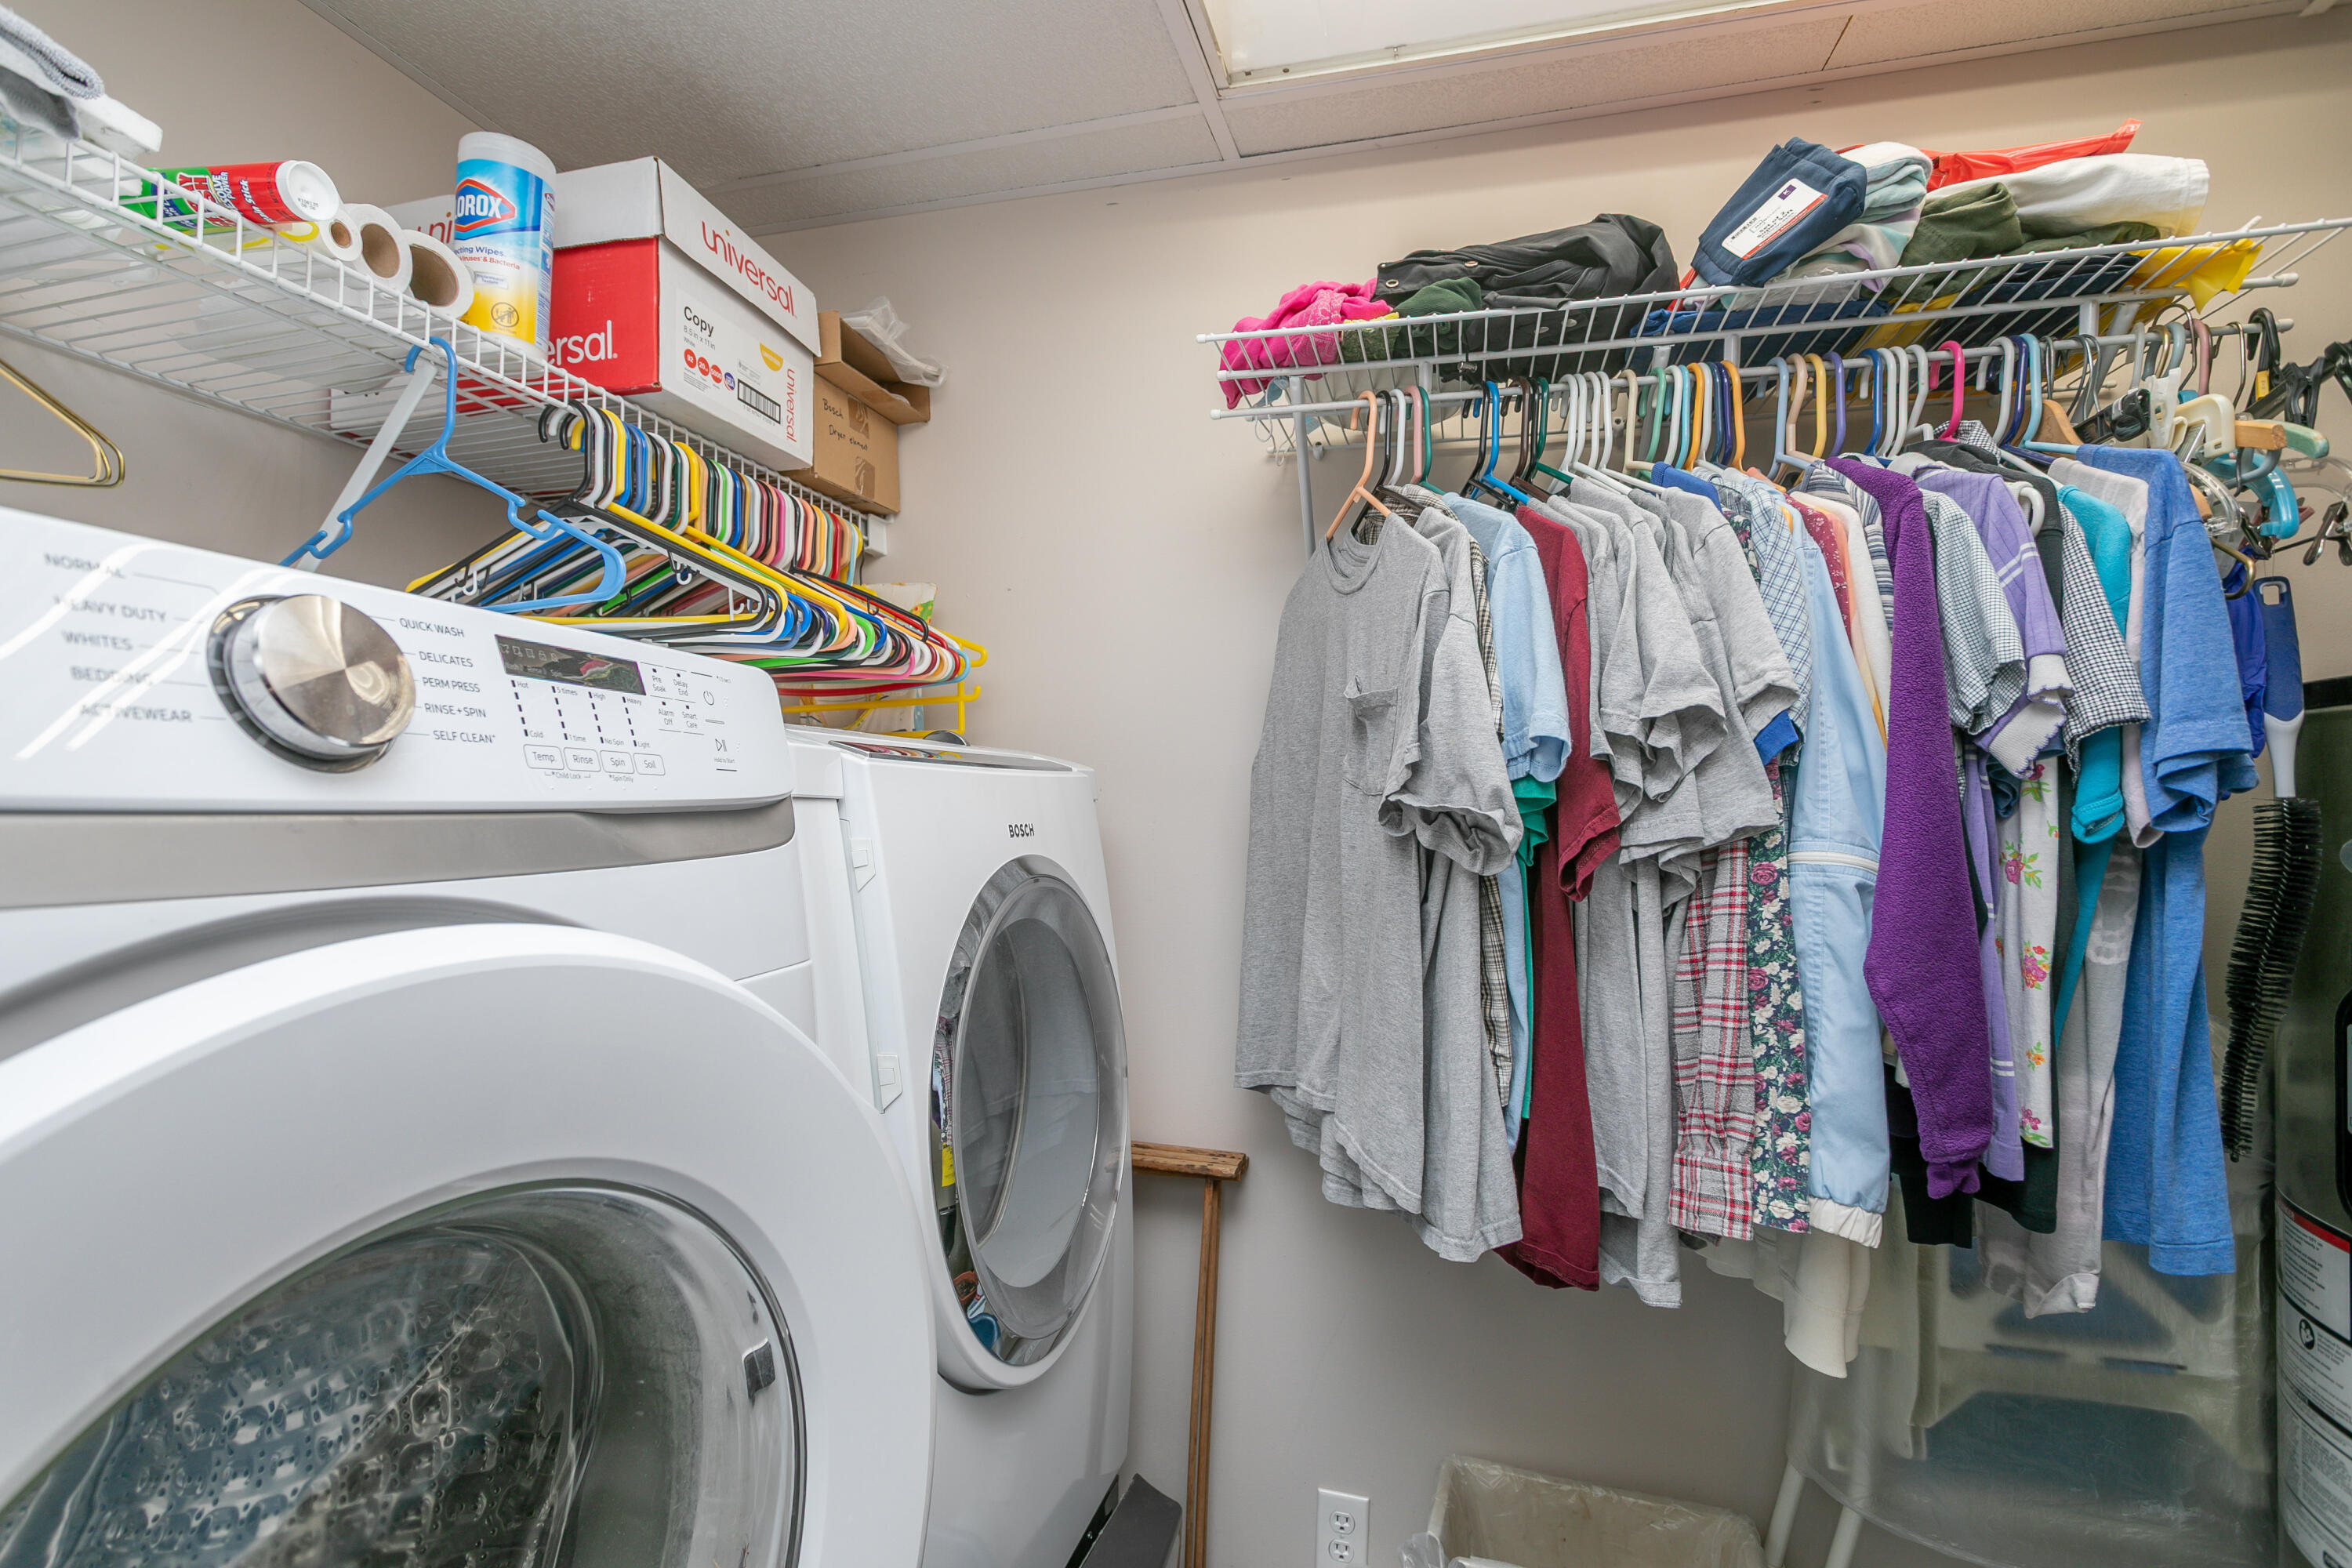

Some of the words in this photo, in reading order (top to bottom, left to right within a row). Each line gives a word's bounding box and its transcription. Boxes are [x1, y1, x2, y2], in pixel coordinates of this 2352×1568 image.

[239, 178, 256, 205] Stick
[455, 194, 502, 219] OROX
[489, 257, 520, 270] Bacteria
[702, 220, 794, 317] universal
[684, 306, 713, 337] Copy
[684, 325, 693, 336] 8.5
[786, 368, 797, 442] universal
[822, 398, 844, 419] Bosch
[829, 424, 845, 440] Dryer
[120, 604, 166, 623] DUTY
[400, 618, 433, 632] QUICK
[434, 624, 465, 637] WASH
[61, 630, 133, 652] WHITES
[419, 651, 474, 668] DELICATES
[422, 677, 450, 689] PERM
[452, 681, 481, 693] PRESS
[673, 679, 688, 689] Delay
[659, 709, 675, 717] Alarm
[682, 711, 698, 720] Smart
[686, 720, 698, 729] Care
[433, 730, 457, 741] SELF
[529, 730, 544, 739] Cold
[573, 754, 593, 764] Rinse
[610, 757, 626, 767] Spin
[644, 760, 657, 769] Soil
[1008, 823, 1035, 838] BOSCH
